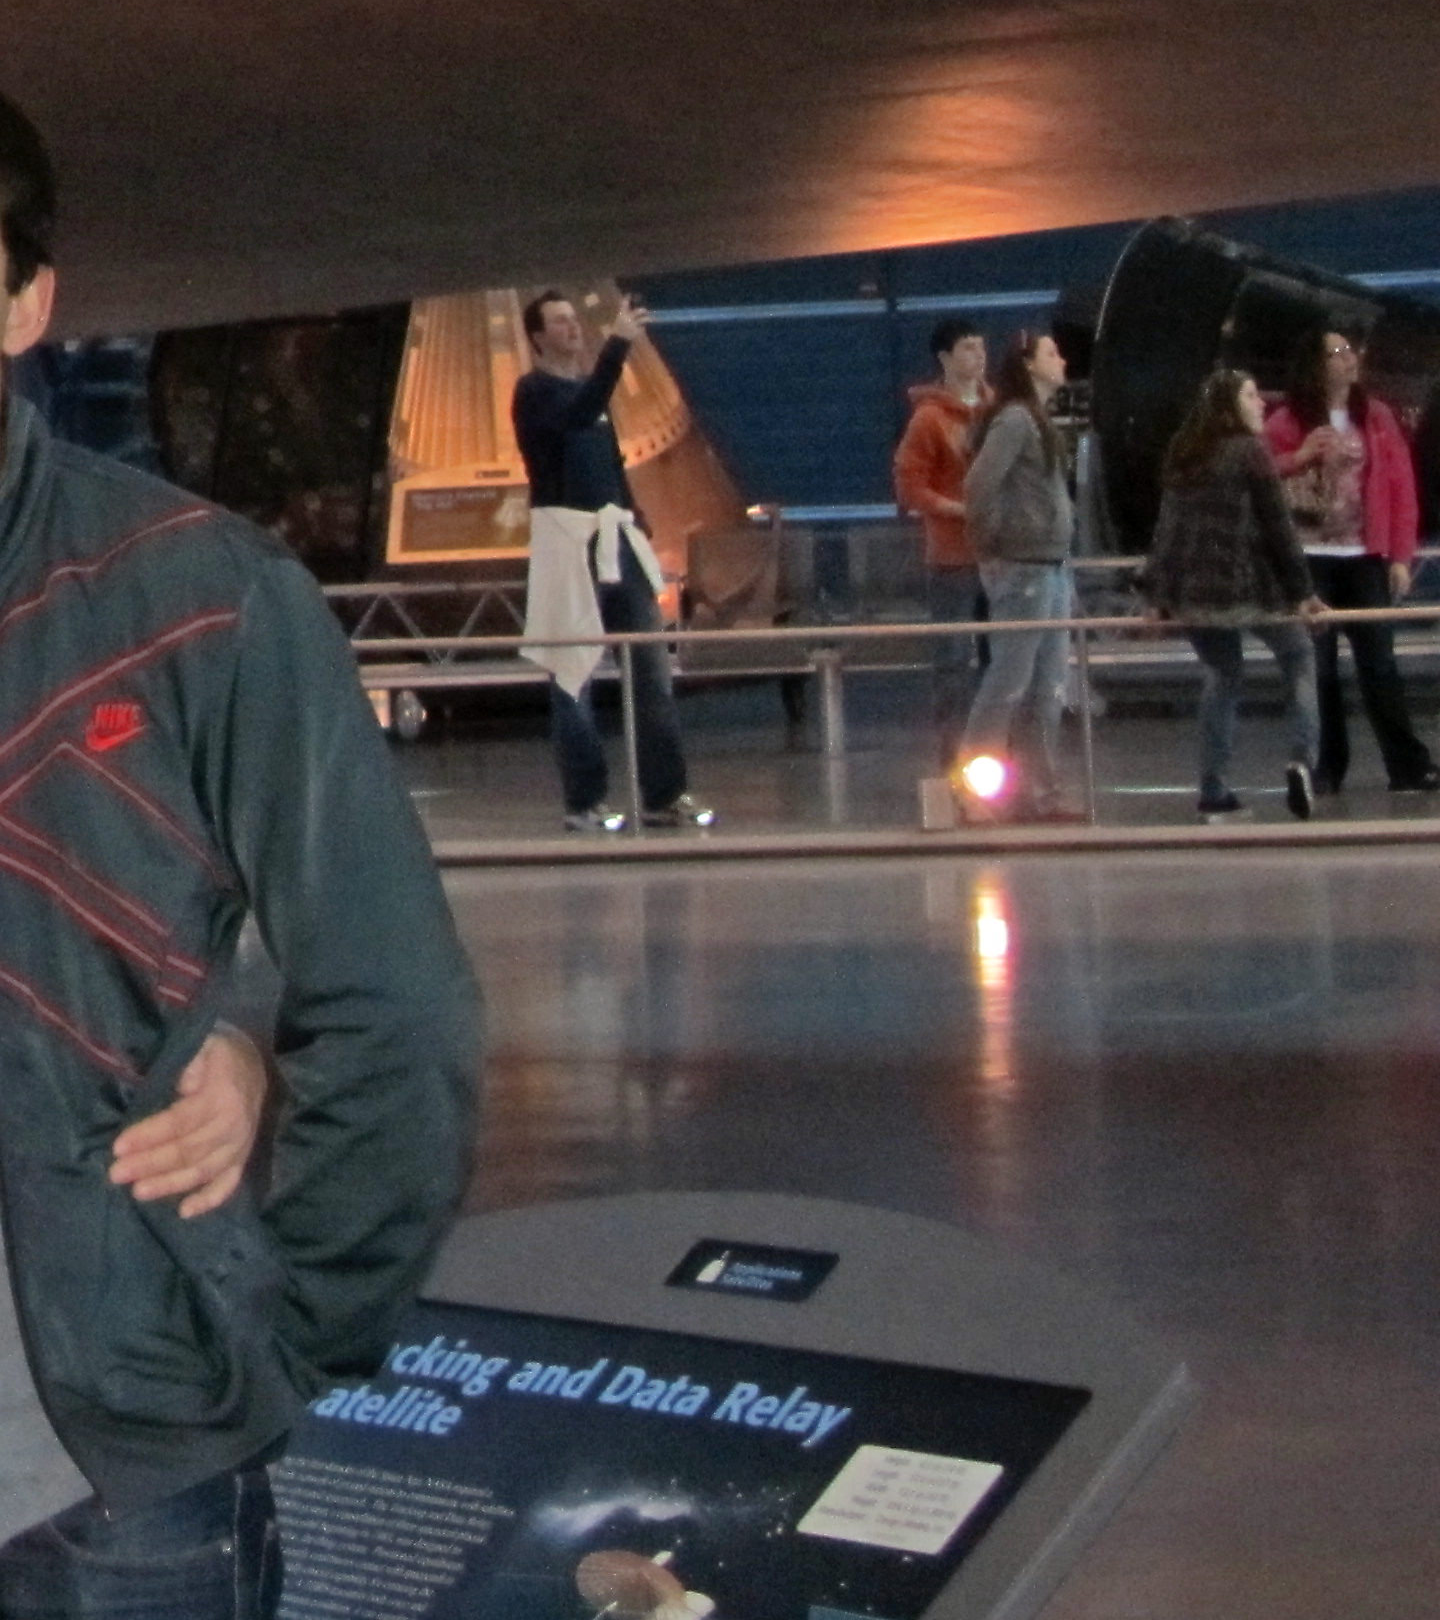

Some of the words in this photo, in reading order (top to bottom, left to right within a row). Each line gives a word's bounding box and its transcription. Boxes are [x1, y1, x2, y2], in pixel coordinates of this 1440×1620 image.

[95, 704, 141, 730] NIKE
[308, 1384, 463, 1435] atellite
[386, 1334, 510, 1397] cking
[507, 1358, 608, 1399] and
[598, 1366, 710, 1416] Data
[711, 1382, 852, 1447] Relay
